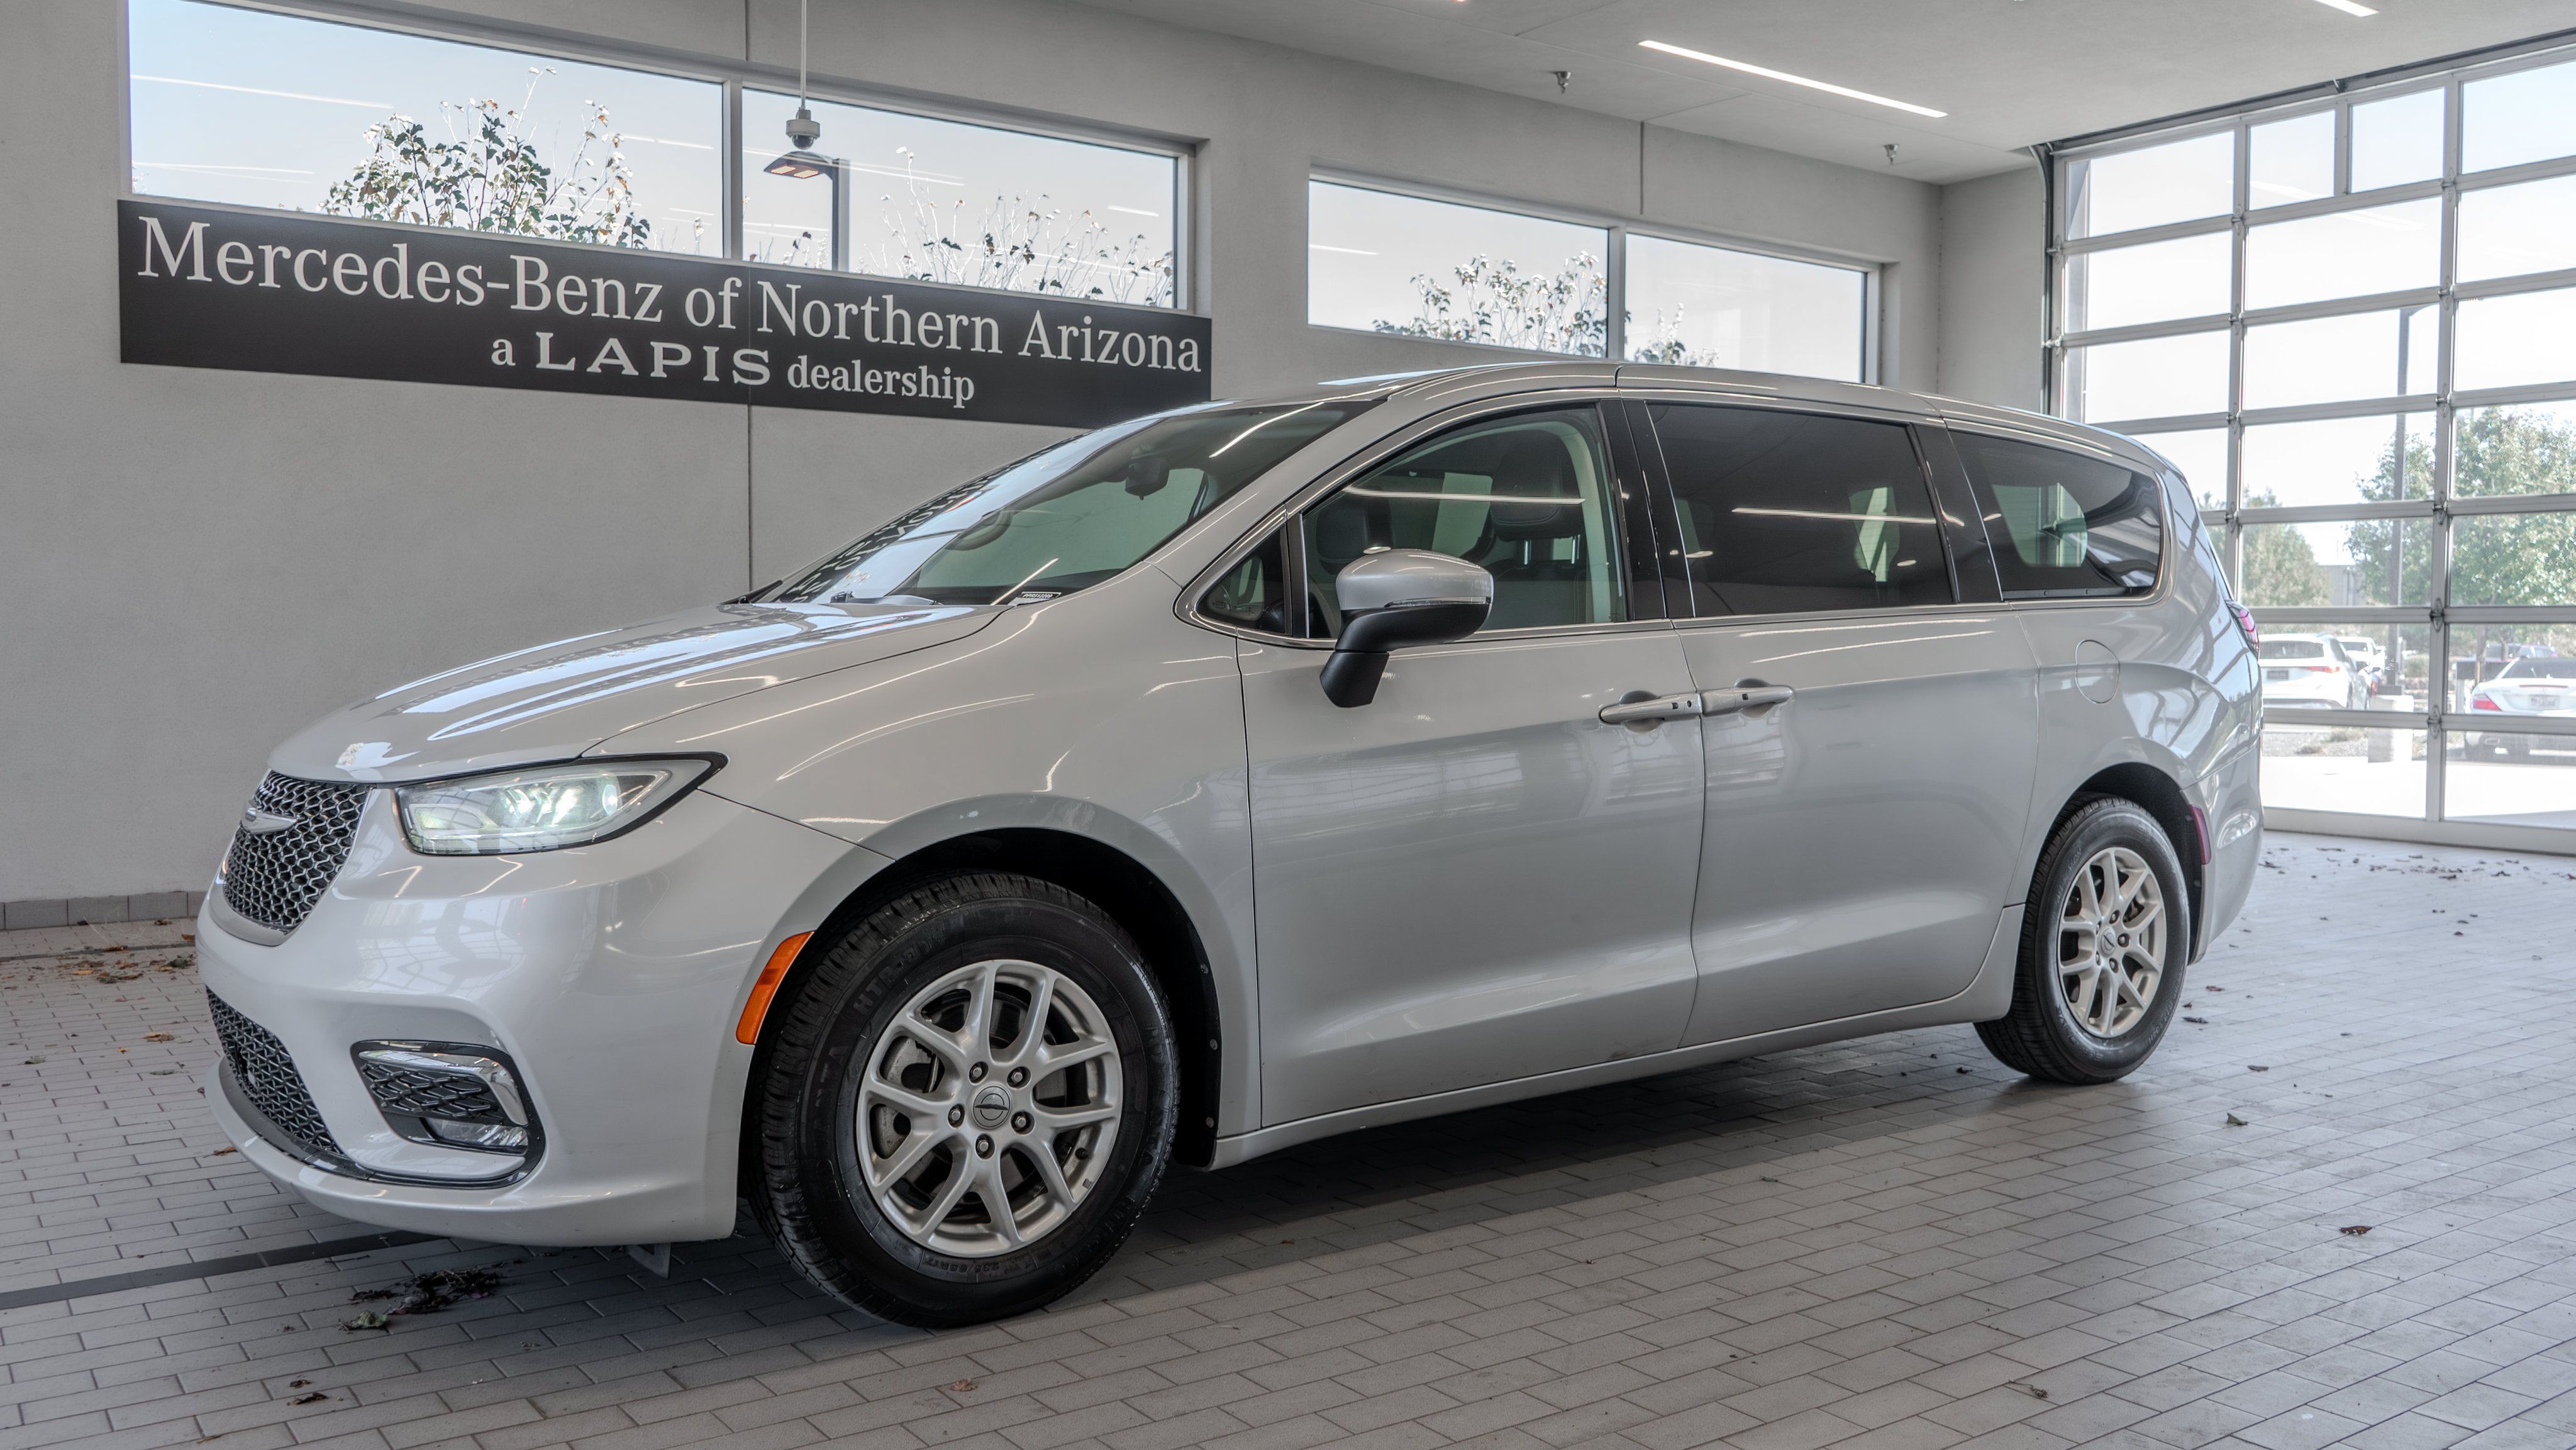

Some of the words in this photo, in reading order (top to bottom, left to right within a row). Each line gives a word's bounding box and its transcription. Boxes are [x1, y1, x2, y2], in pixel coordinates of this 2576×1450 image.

[137, 216, 663, 323] Mercedes-Benz
[685, 276, 743, 330] of
[757, 280, 1004, 355] Northern
[1018, 310, 1202, 373] Arizona
[491, 338, 516, 367] a
[535, 332, 771, 386] LAPIS
[787, 355, 975, 410] dealership
